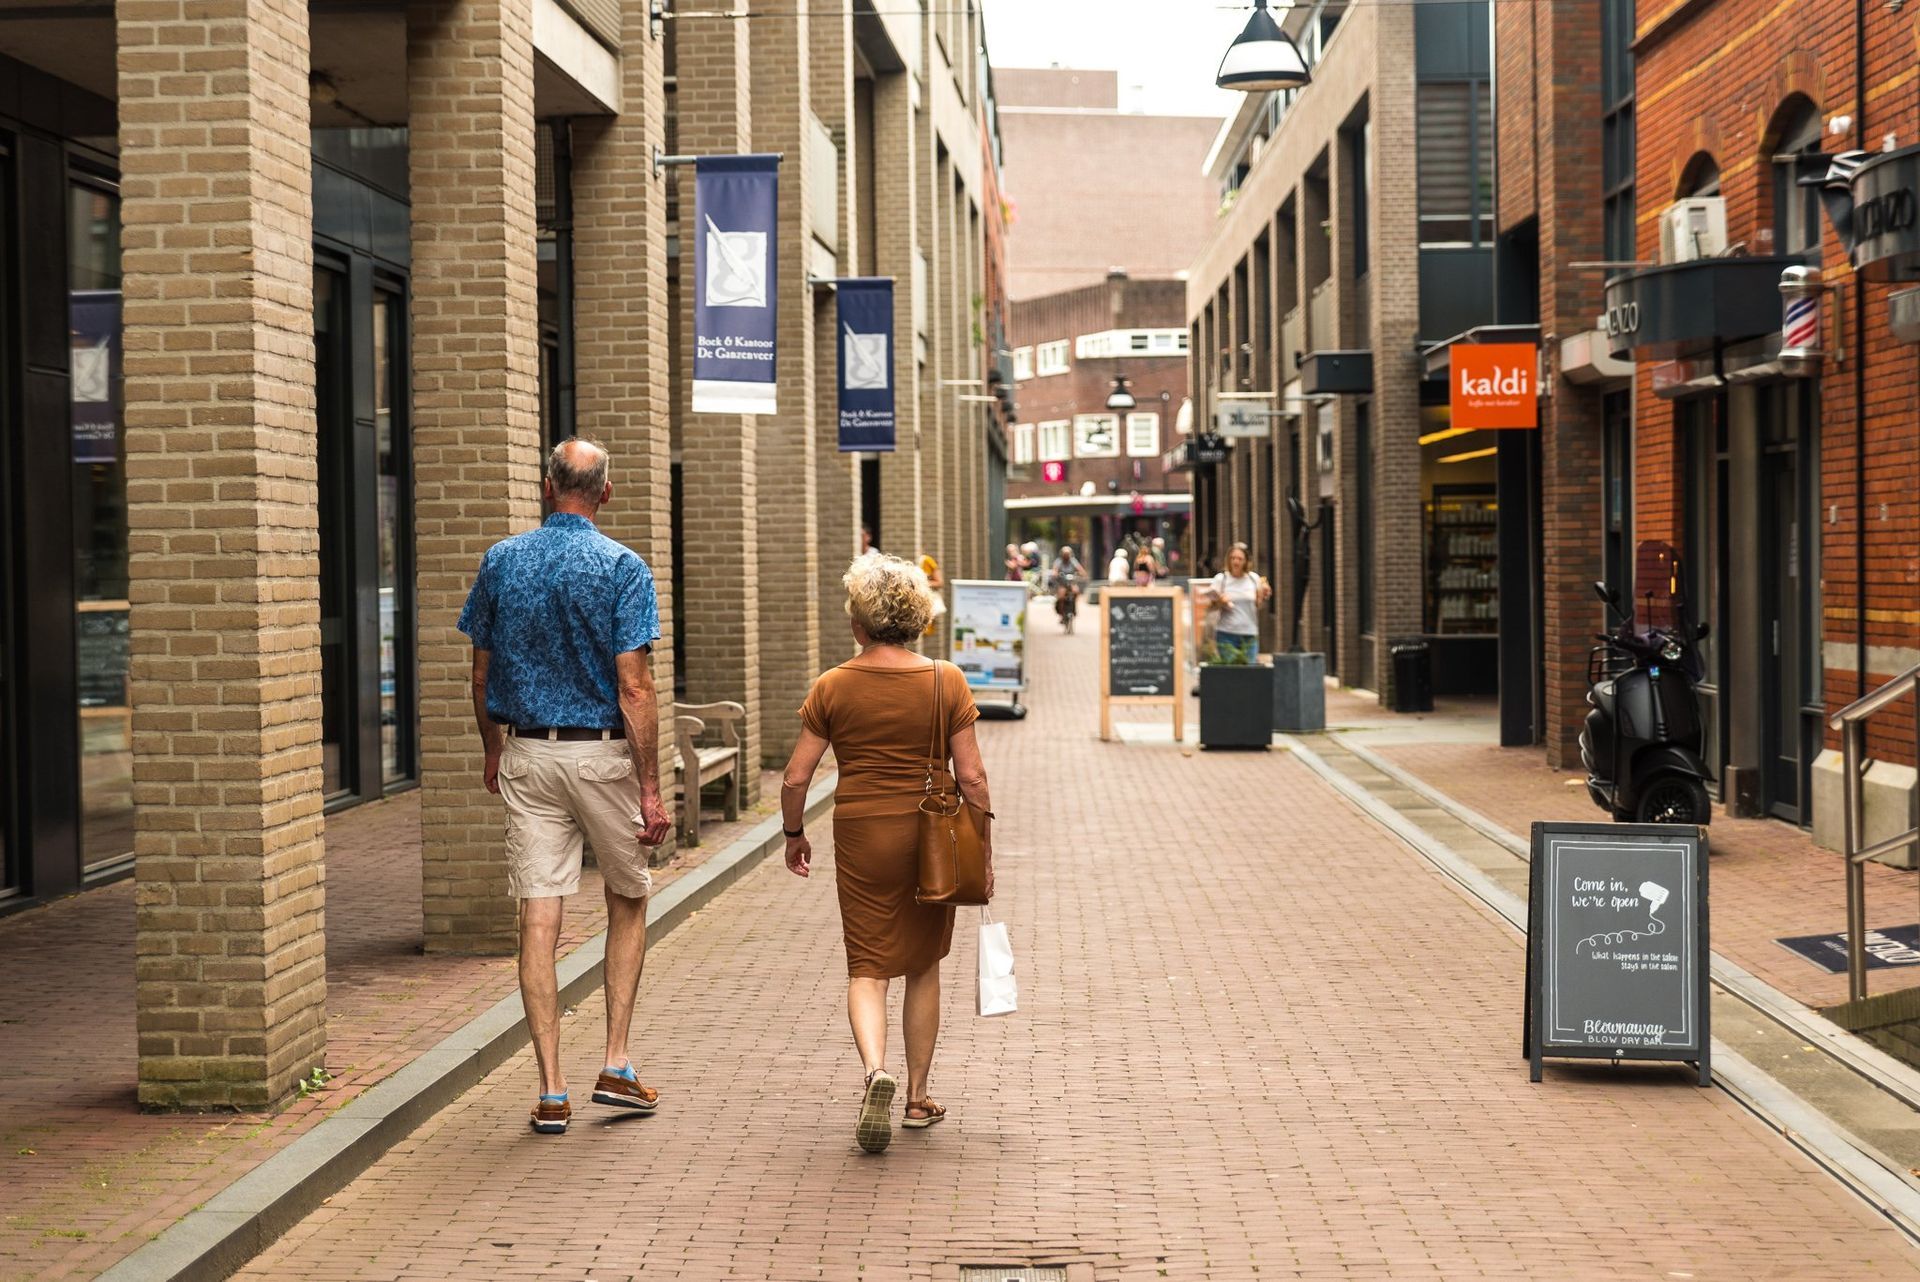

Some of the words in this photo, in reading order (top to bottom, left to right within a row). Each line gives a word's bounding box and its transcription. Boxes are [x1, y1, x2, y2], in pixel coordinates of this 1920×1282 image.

[724, 335, 733, 347] &
[735, 336, 774, 348] Kantoor
[697, 346, 713, 359] De
[714, 347, 774, 361] Ganzenveer
[1461, 365, 1528, 396] kaldi
[1574, 876, 1605, 892] Come
[1610, 896, 1639, 913] open
[1591, 950, 1610, 960] What
[1612, 952, 1640, 962] happens
[1642, 953, 1650, 962] in
[1650, 953, 1661, 962] the
[1662, 952, 1679, 963] salon
[1641, 963, 1649, 971] in
[1649, 962, 1660, 971] the
[1583, 1019, 1667, 1040] Blownaway
[1588, 1034, 1618, 1044] BLOW
[1621, 1036, 1641, 1045] DRY
[1643, 1036, 1664, 1046] BAR
